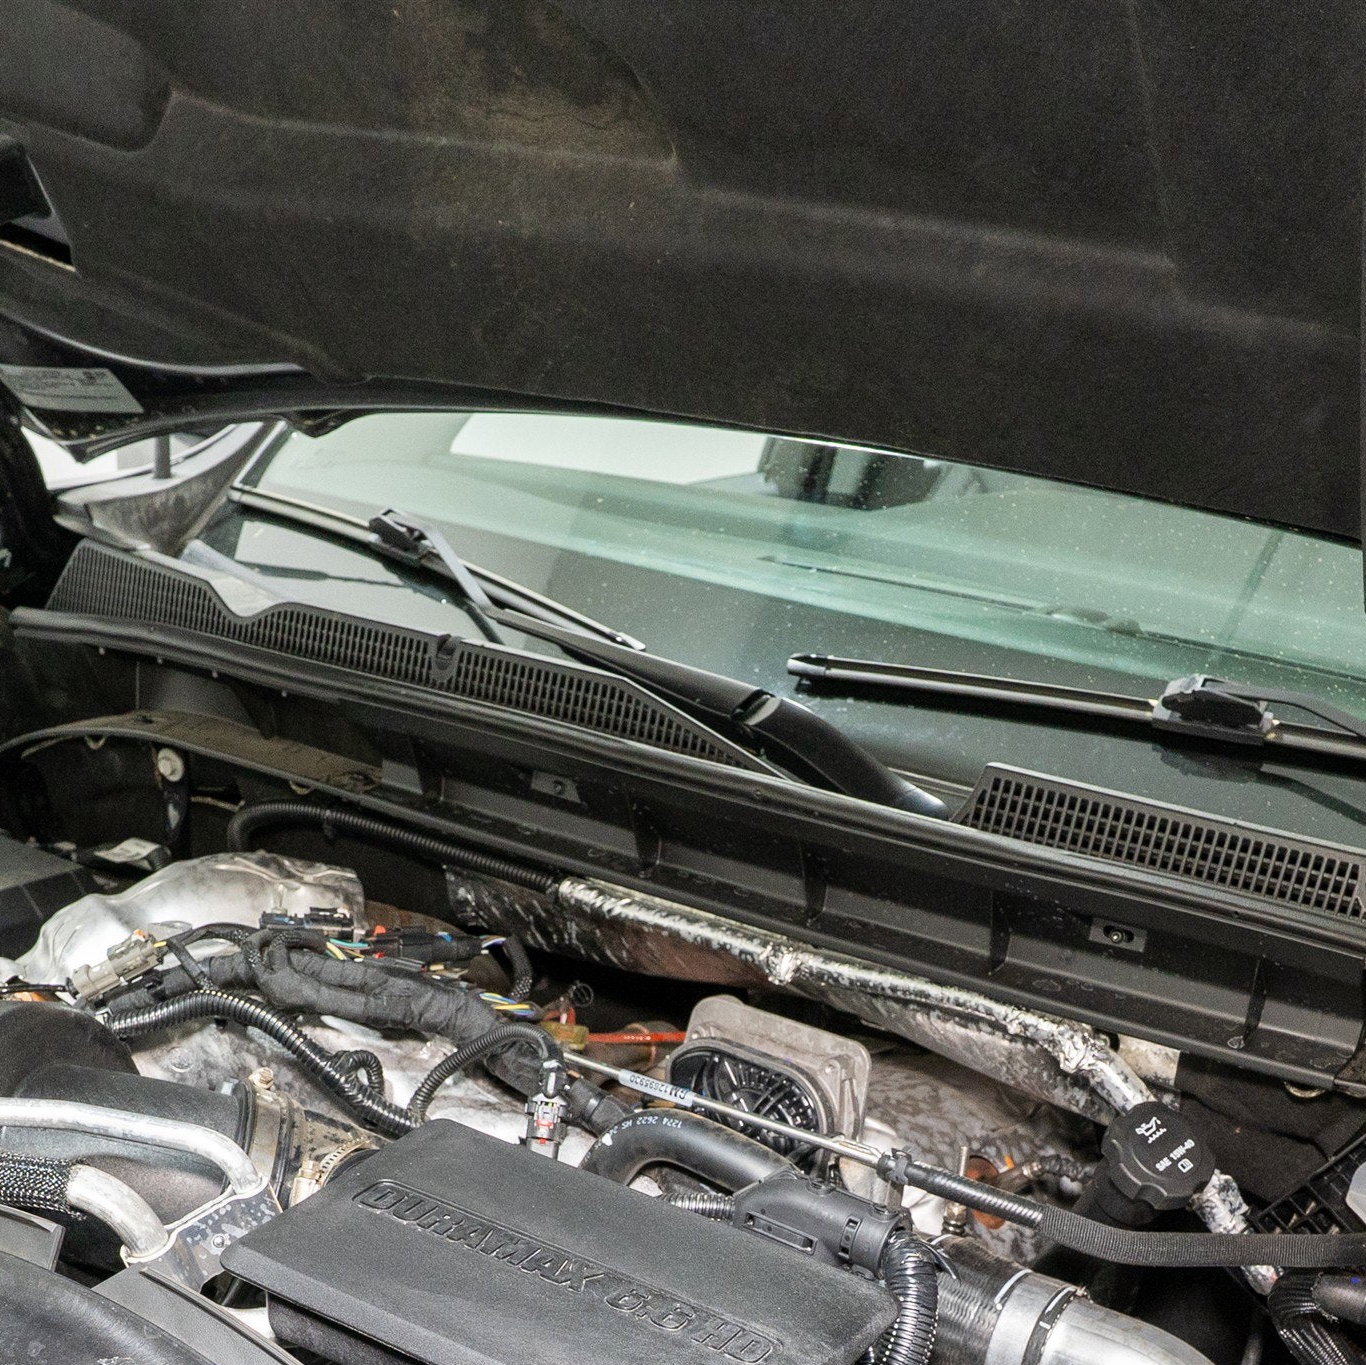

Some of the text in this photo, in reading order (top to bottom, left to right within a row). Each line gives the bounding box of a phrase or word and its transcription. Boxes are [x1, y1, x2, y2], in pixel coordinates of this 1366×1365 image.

[669, 1086, 687, 1100] GM
[1155, 1156, 1172, 1172] SAE
[357, 1186, 777, 1364] DURAMAX 6.6 HD
